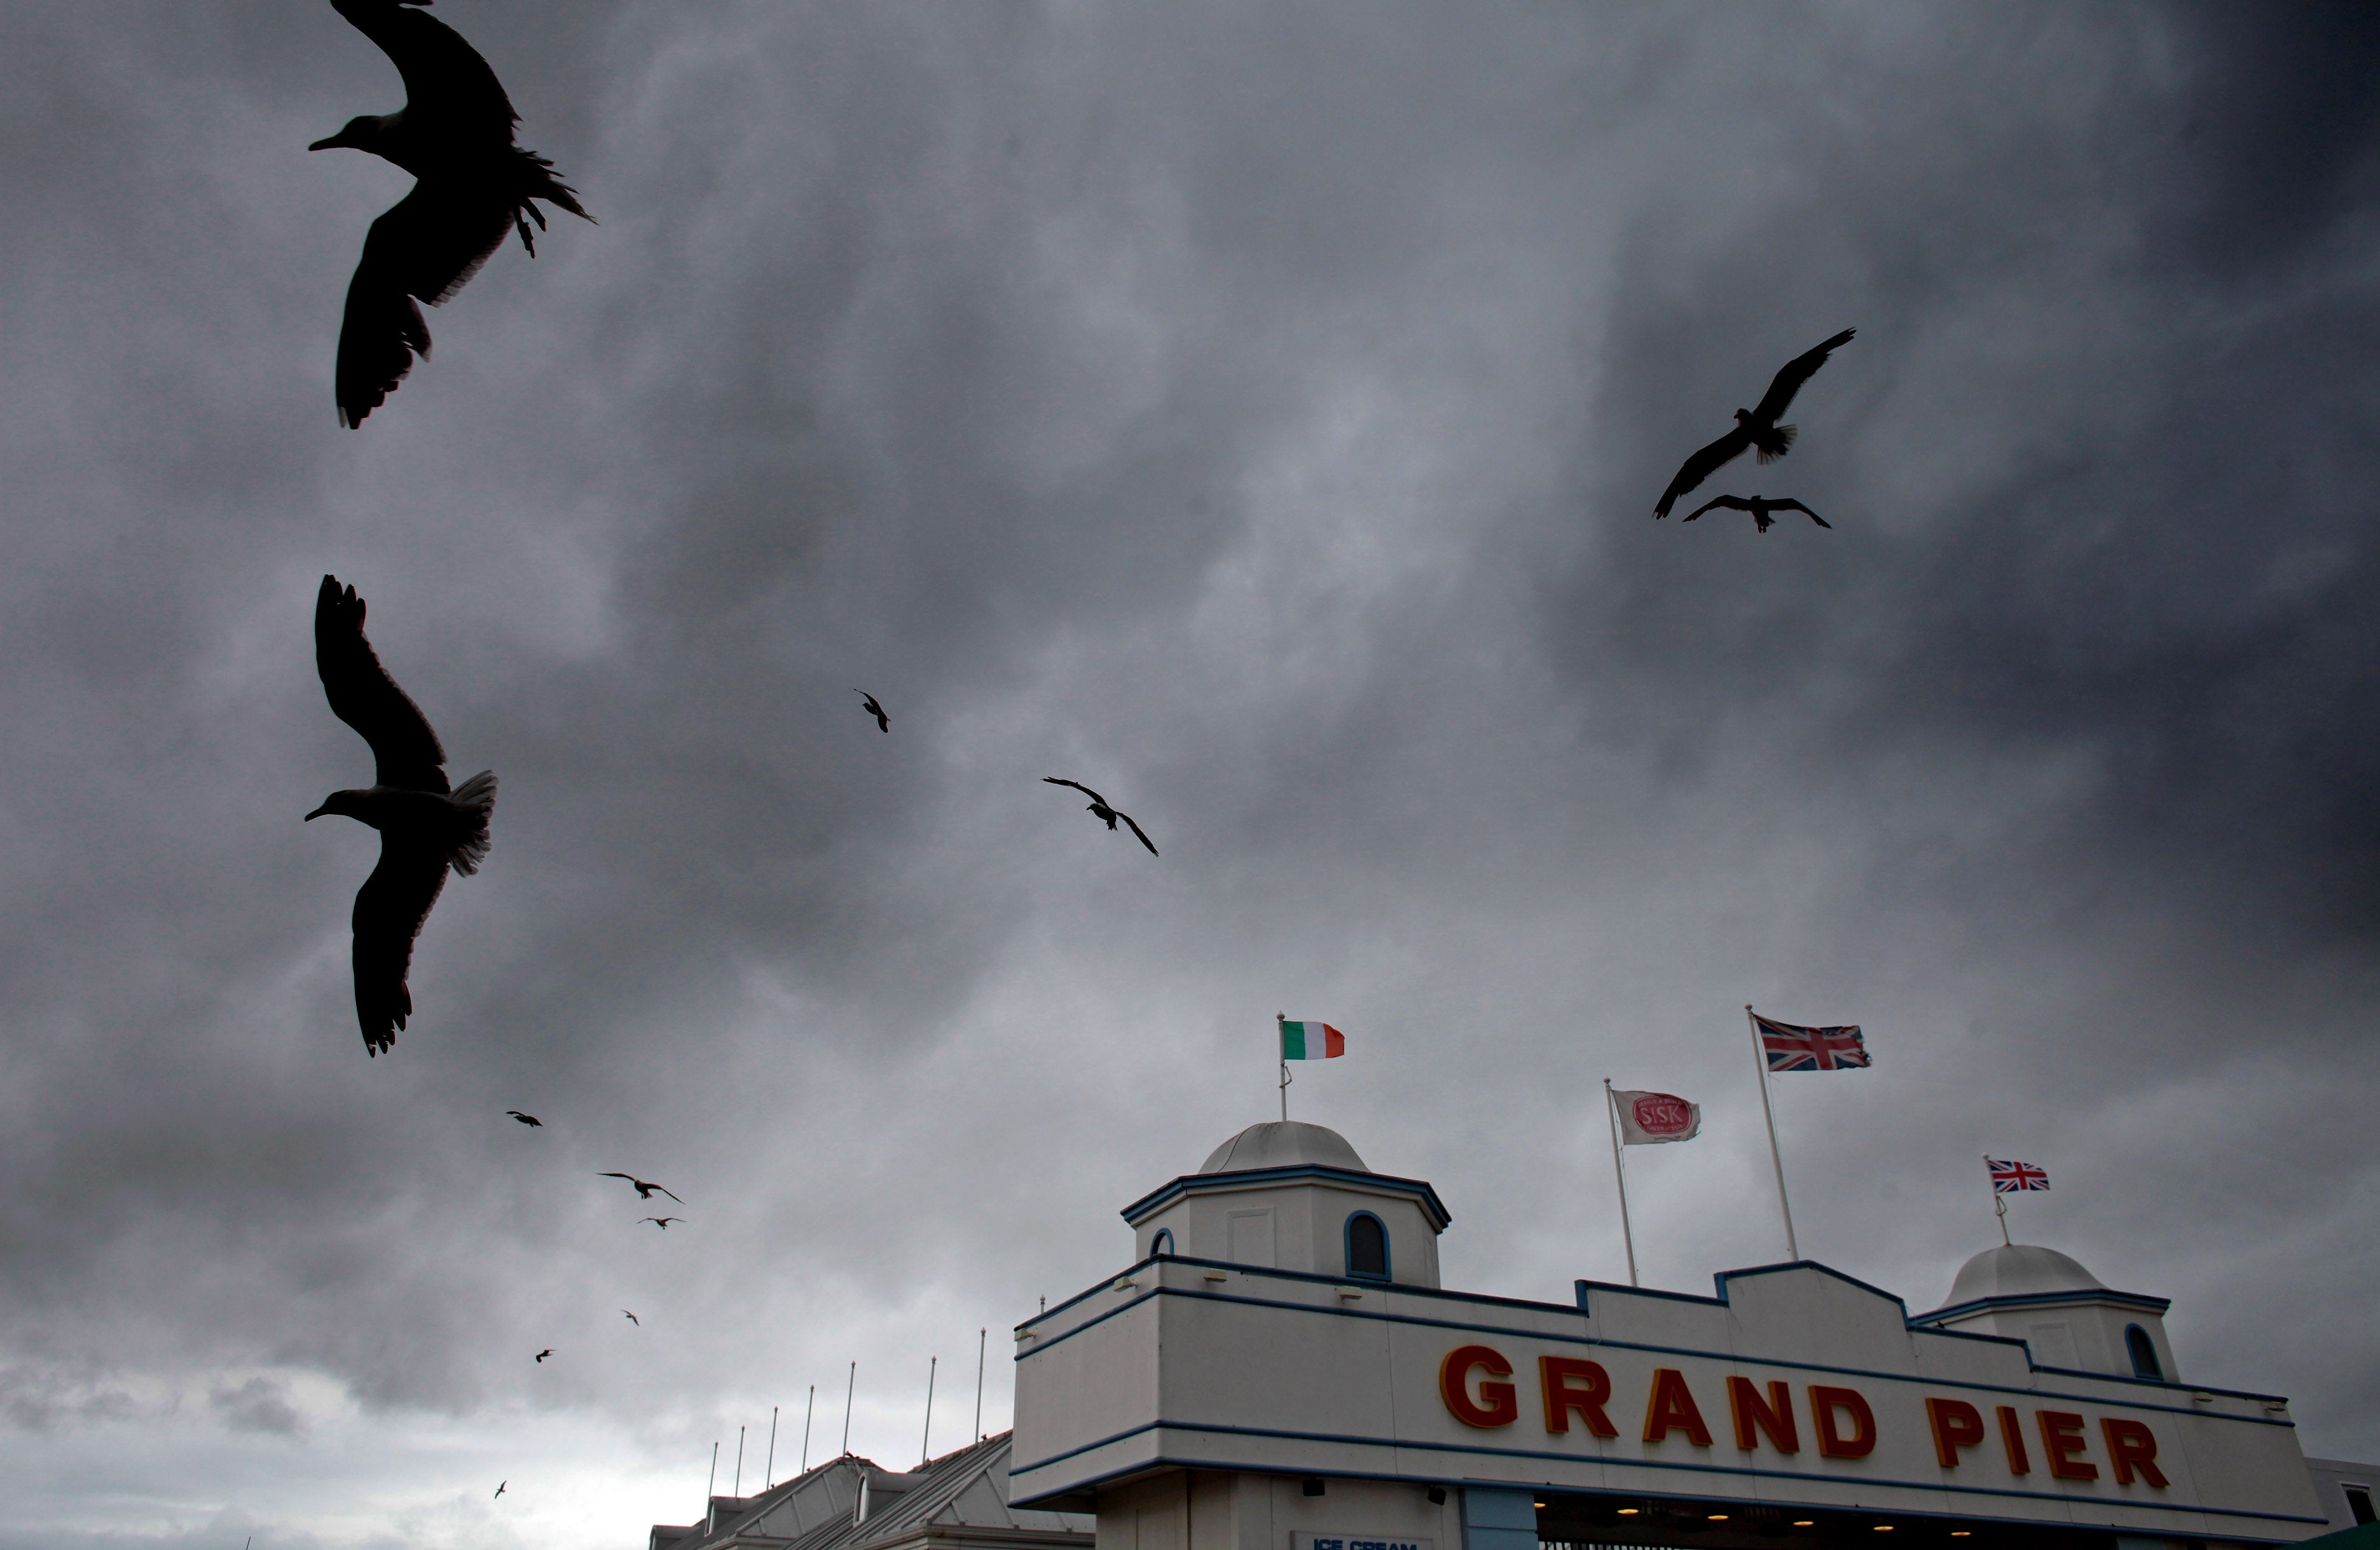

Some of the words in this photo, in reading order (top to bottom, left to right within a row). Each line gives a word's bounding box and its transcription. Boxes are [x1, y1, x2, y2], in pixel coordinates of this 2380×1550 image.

[1641, 1105, 1683, 1124] SISK
[1440, 1345, 1876, 1458] GRAND
[1925, 1397, 2170, 1487] PIER
[1314, 1539, 1343, 1550] ICE
